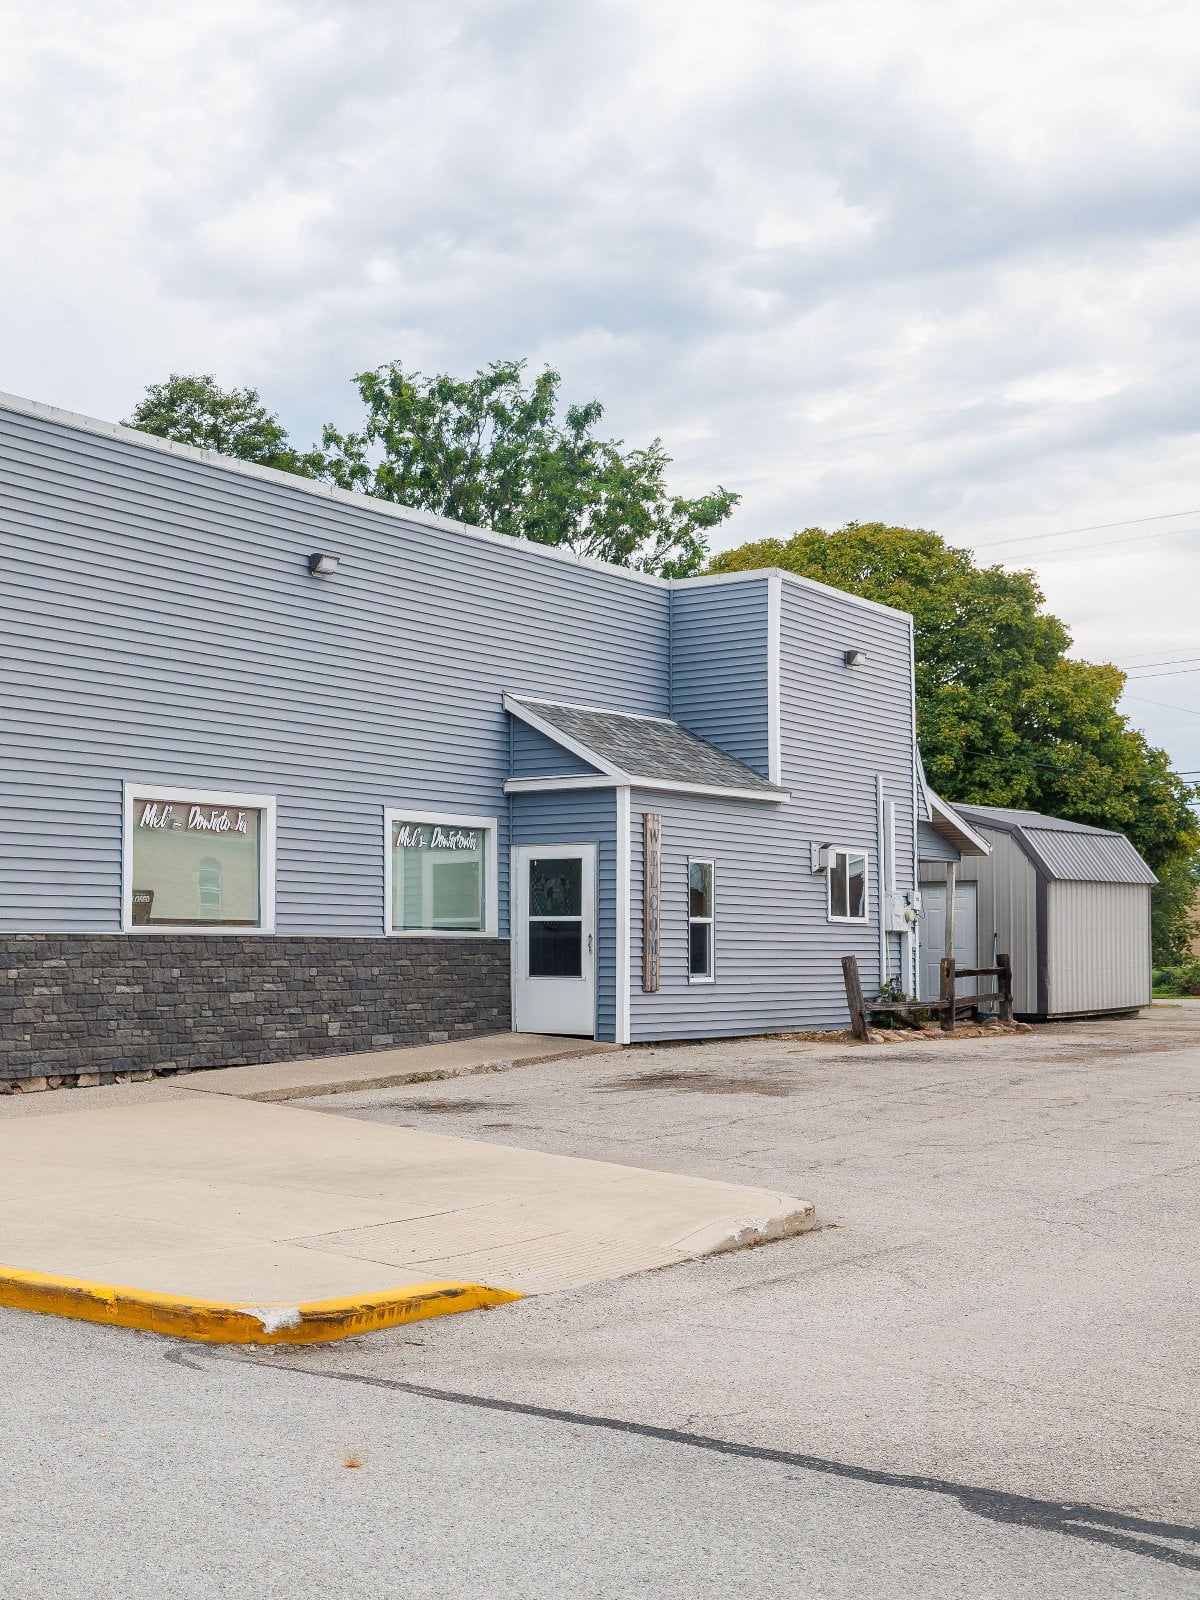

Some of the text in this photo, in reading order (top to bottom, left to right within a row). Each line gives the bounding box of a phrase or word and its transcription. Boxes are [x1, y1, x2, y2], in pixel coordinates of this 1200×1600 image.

[397, 825, 477, 851] Mel's Downtown
[649, 828, 659, 977] WELCOME
